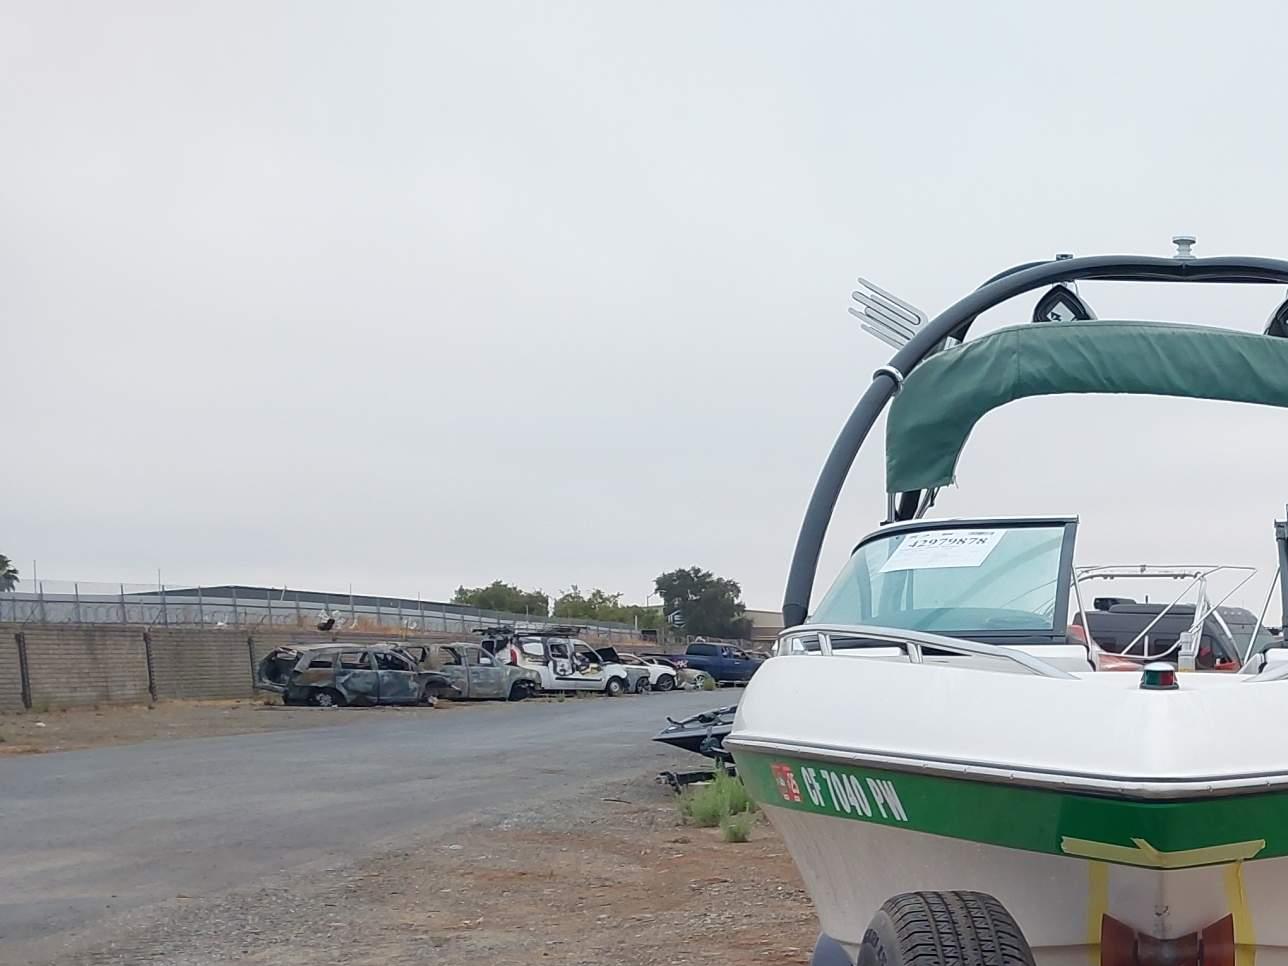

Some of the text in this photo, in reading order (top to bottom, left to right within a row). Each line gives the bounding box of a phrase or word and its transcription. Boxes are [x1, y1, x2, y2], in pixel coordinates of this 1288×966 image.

[908, 537, 989, 548] 42979878
[800, 766, 825, 807] CF
[820, 769, 872, 817] 7040
